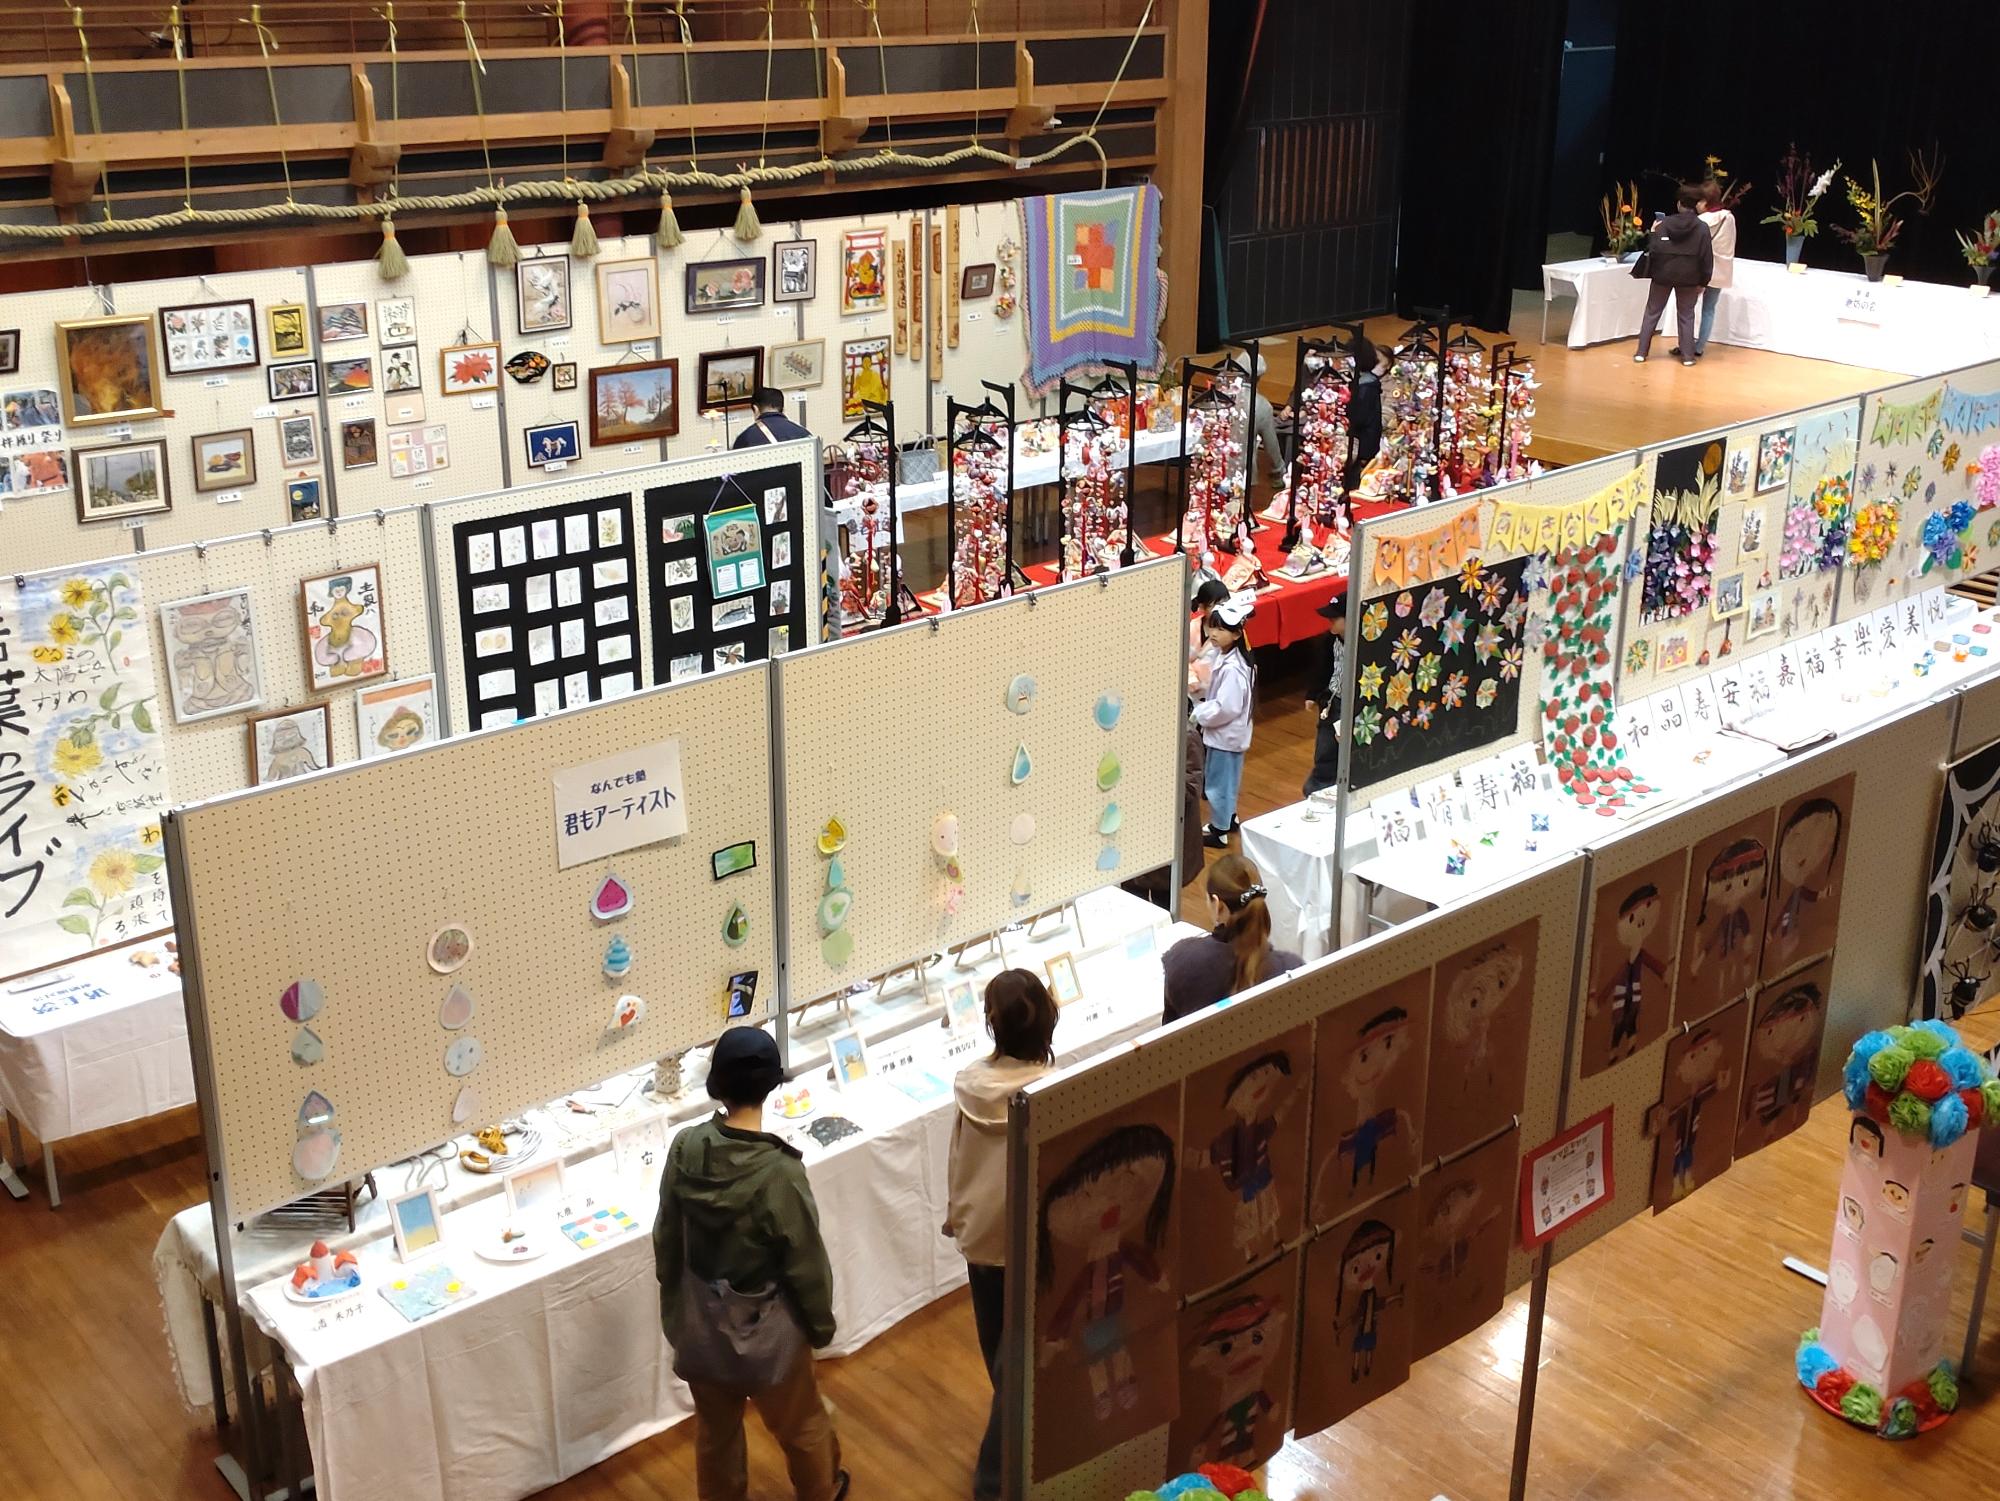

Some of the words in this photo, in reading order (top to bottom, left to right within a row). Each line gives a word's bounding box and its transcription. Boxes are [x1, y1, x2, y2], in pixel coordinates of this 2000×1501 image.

[1805, 648, 1825, 678] 福
[1721, 677, 1740, 707] 安
[1661, 699, 1682, 731] 晶
[1627, 716, 1649, 748] 和
[591, 769, 646, 794] なんでも塾
[1473, 774, 1499, 810] 寿
[1511, 760, 1536, 796] 福
[564, 786, 676, 836] 君もアーティスト
[1382, 810, 1411, 847] 福
